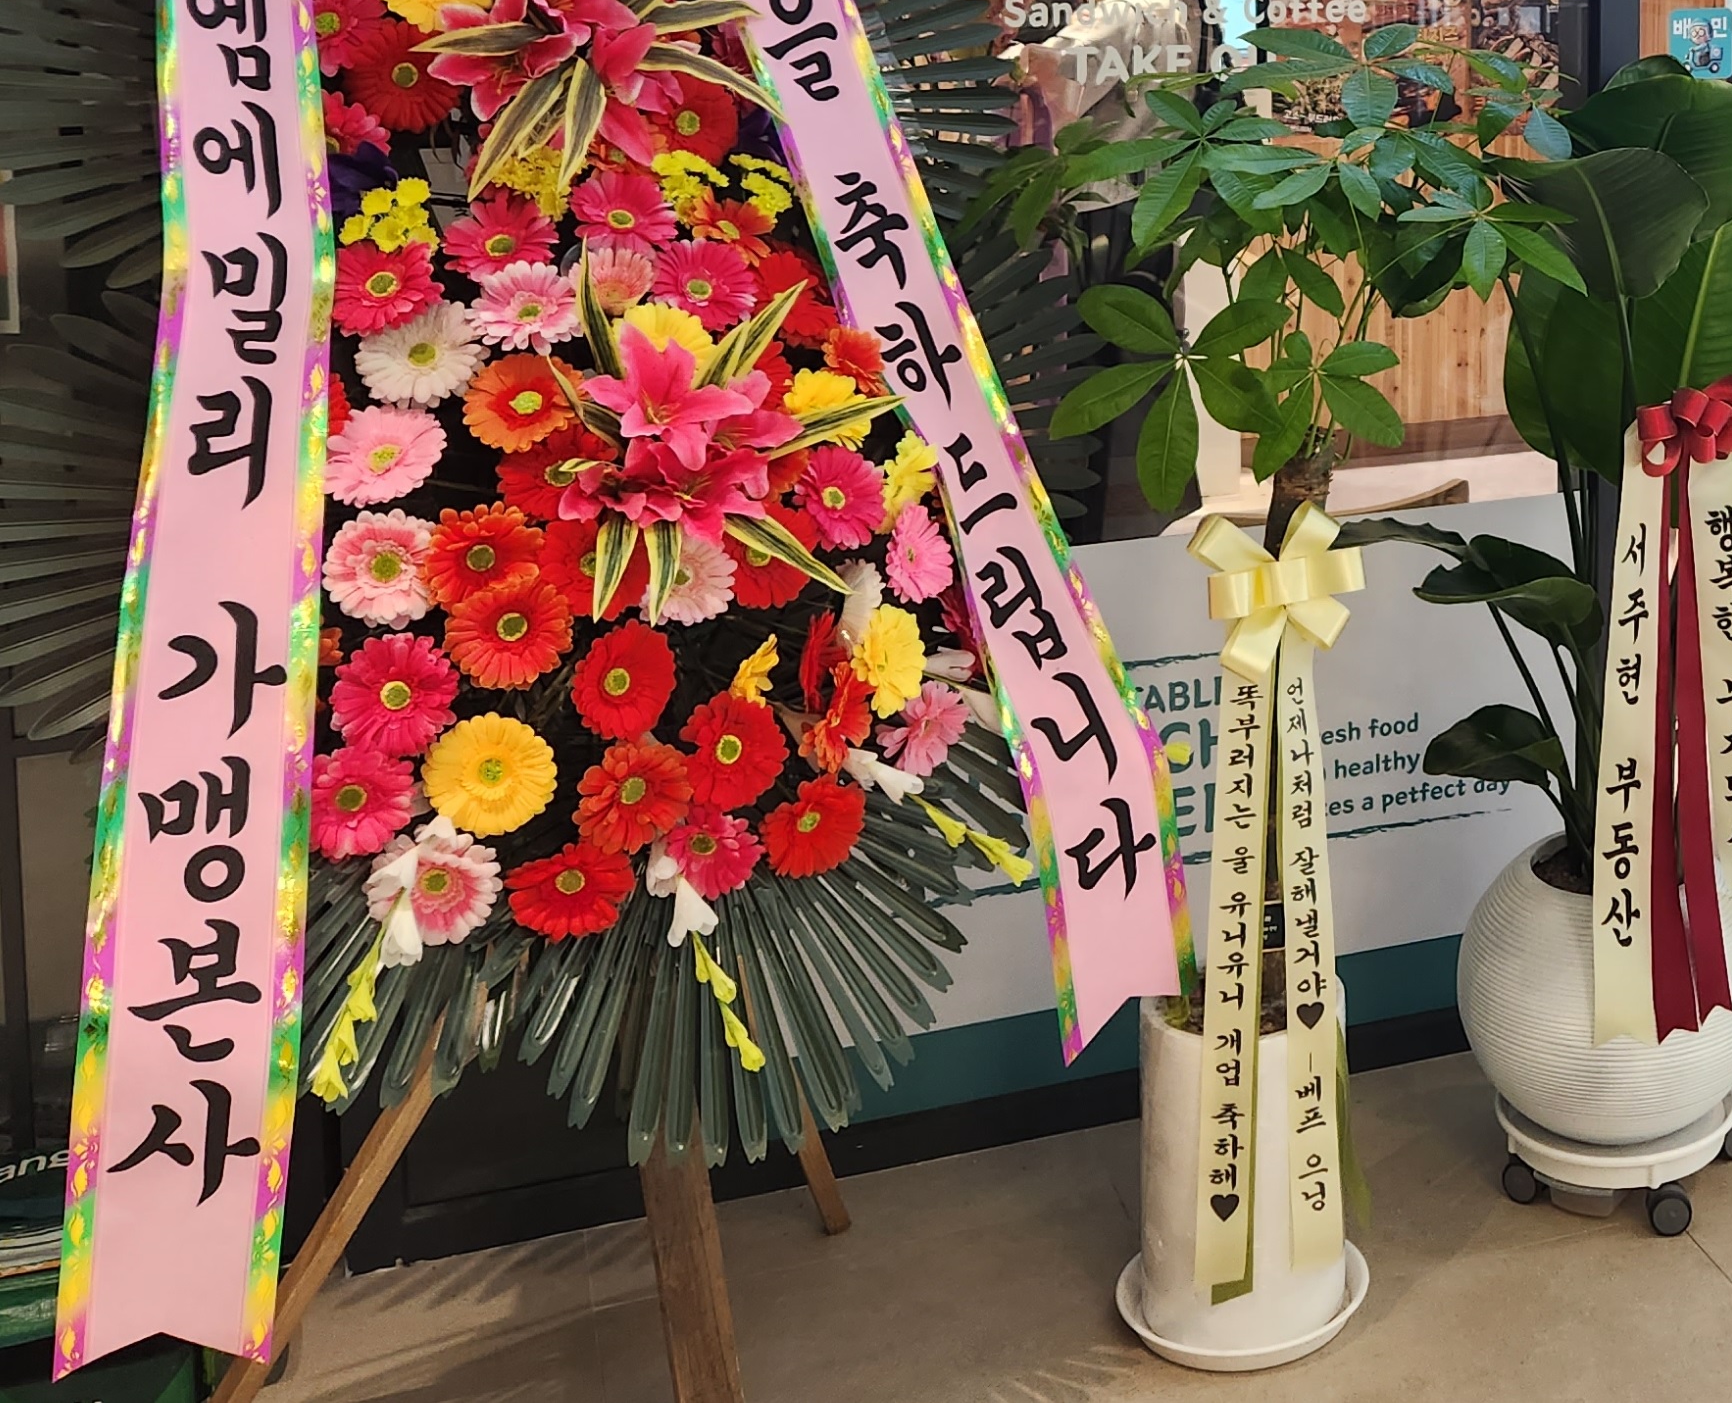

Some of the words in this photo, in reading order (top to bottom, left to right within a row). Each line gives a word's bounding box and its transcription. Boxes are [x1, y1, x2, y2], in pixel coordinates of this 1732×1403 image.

[1066, 44, 1193, 86] TAKE
[1615, 522, 1649, 706] 서주현
[1223, 683, 1265, 829] 똑부러지는
[1286, 677, 1315, 829] 언제나처럼
[1321, 720, 1361, 746] esh
[1367, 712, 1420, 740] food
[1334, 751, 1421, 780] healthy
[1361, 795, 1375, 811] a
[1601, 757, 1642, 947] 부동산
[107, 600, 287, 1207] 가맹본사
[1221, 846, 1256, 875] 울
[1216, 891, 1252, 1011] 유니유니
[1289, 846, 1328, 999] 잘해낼거야
[1214, 1028, 1243, 1087] 개업
[1209, 1103, 1245, 1191] 축하해
